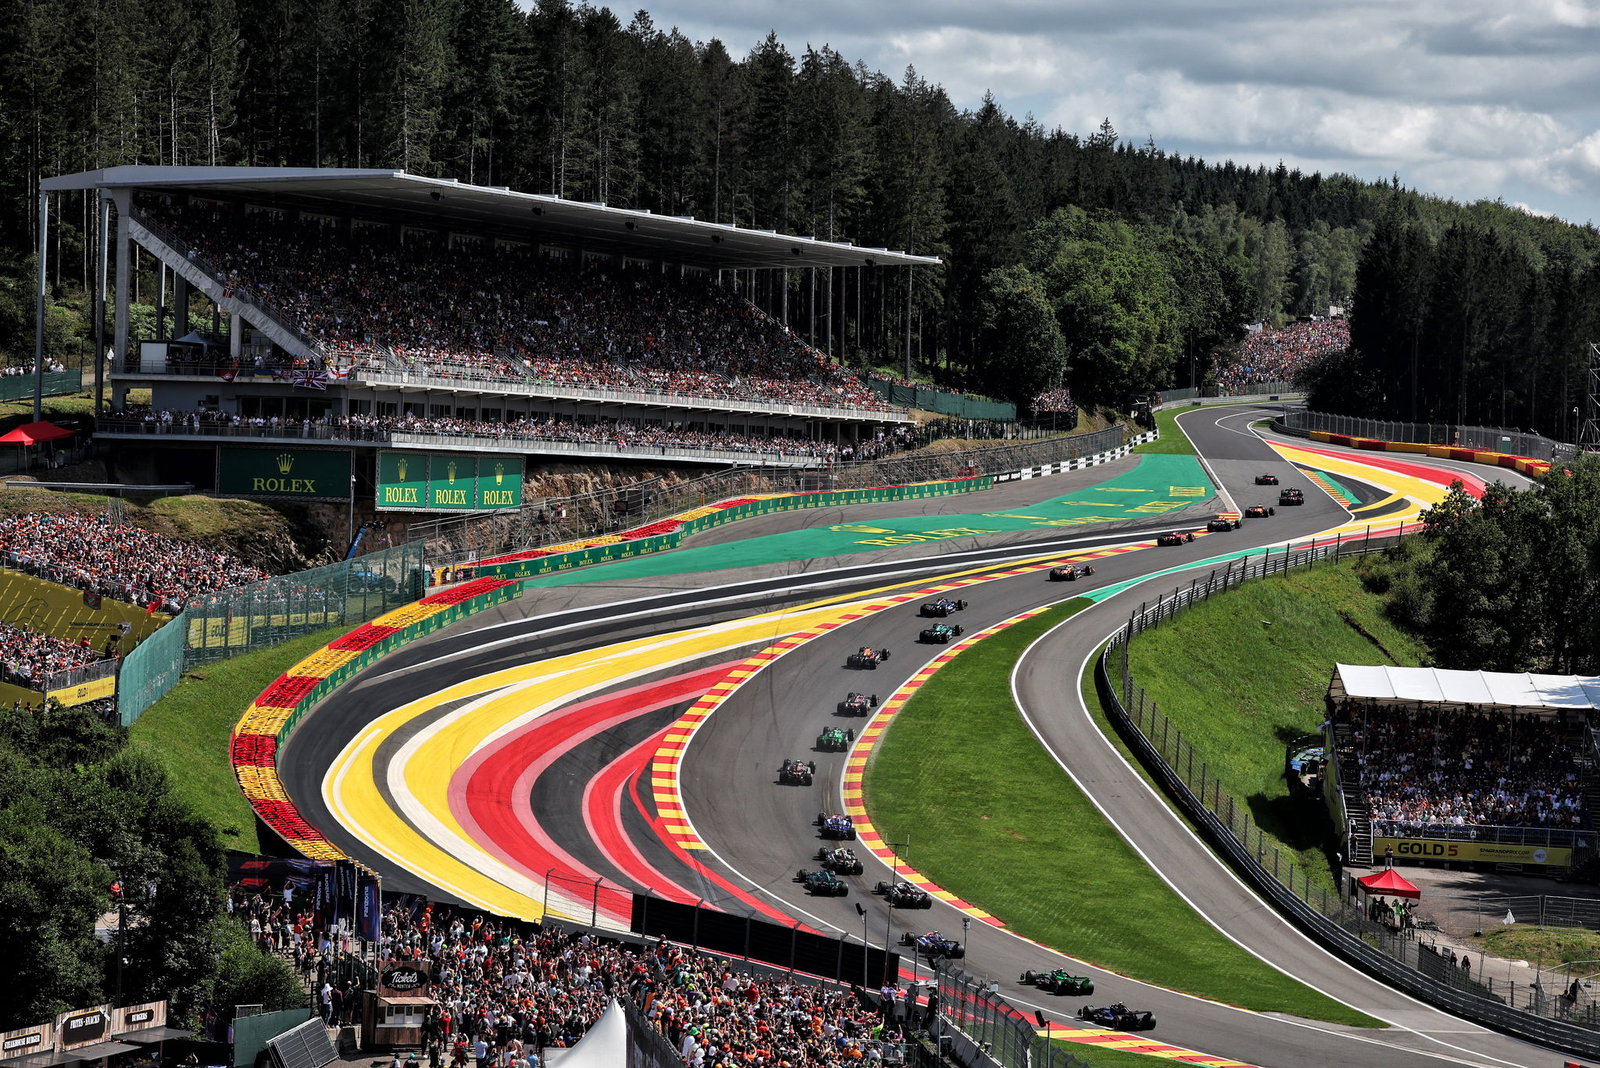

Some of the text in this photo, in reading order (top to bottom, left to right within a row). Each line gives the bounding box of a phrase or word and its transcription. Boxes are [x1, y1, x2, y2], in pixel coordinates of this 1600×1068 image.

[252, 477, 316, 493] ROLEX
[385, 487, 417, 503] ROLEX
[435, 489, 466, 505] ROLEX
[483, 490, 513, 505] ROLEX
[853, 528, 1000, 547] ROLEX
[559, 562, 573, 570] ROLEX
[514, 570, 531, 578] ROLEX
[1397, 842, 1459, 857] GOLD 5
[391, 971, 418, 984] Tickets
